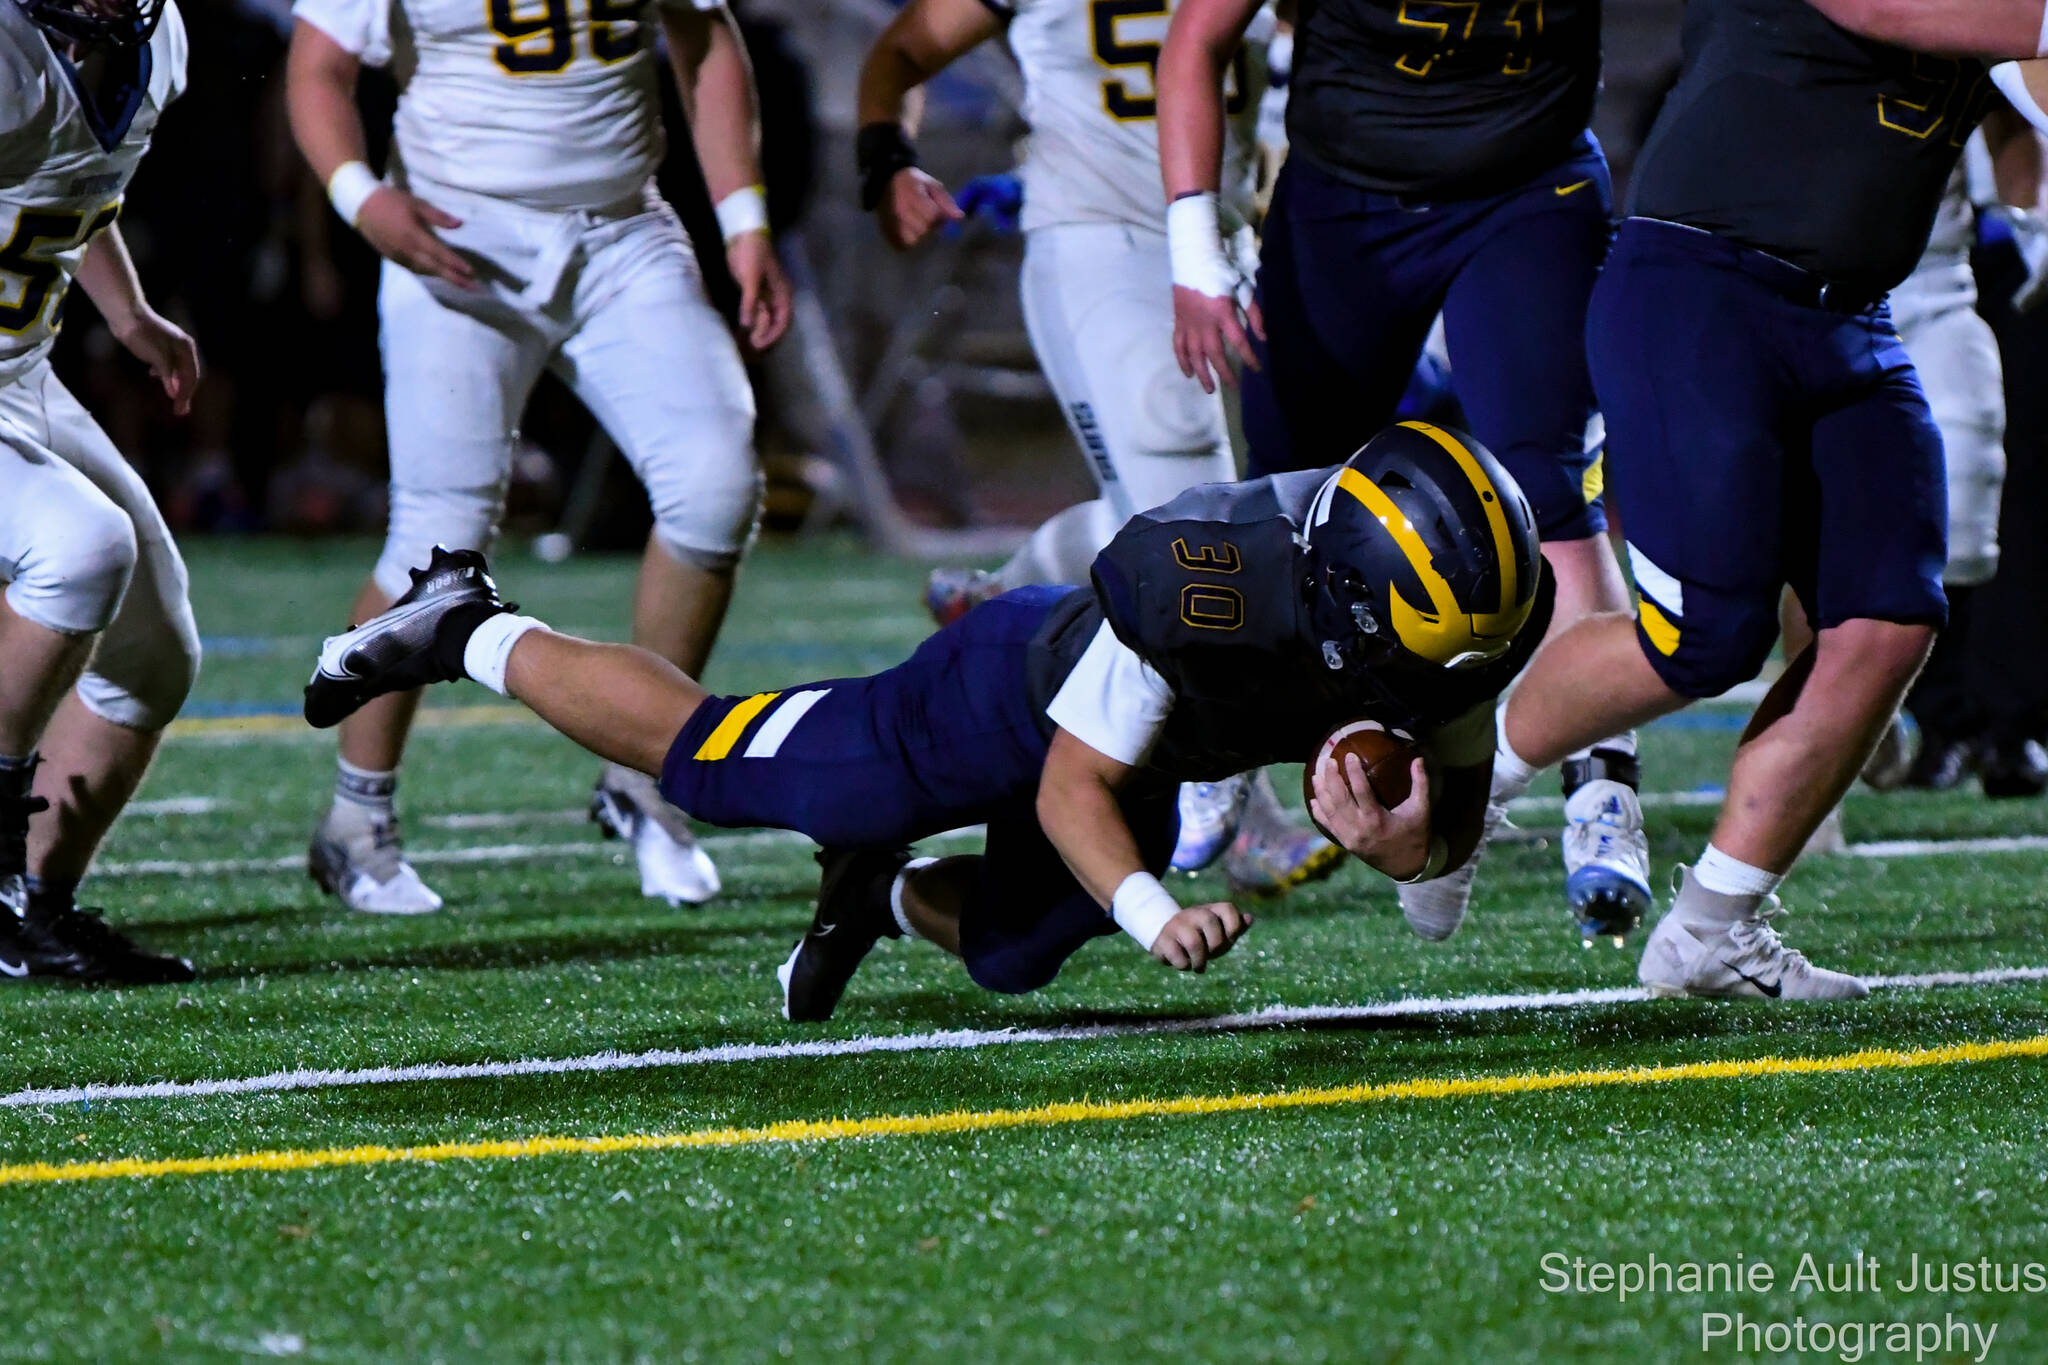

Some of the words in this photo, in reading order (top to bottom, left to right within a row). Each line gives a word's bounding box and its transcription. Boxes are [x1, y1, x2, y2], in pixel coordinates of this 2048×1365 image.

[1089, 0, 1248, 122] 5
[1395, 0, 1543, 77] 71
[1171, 537, 1244, 630] 30
